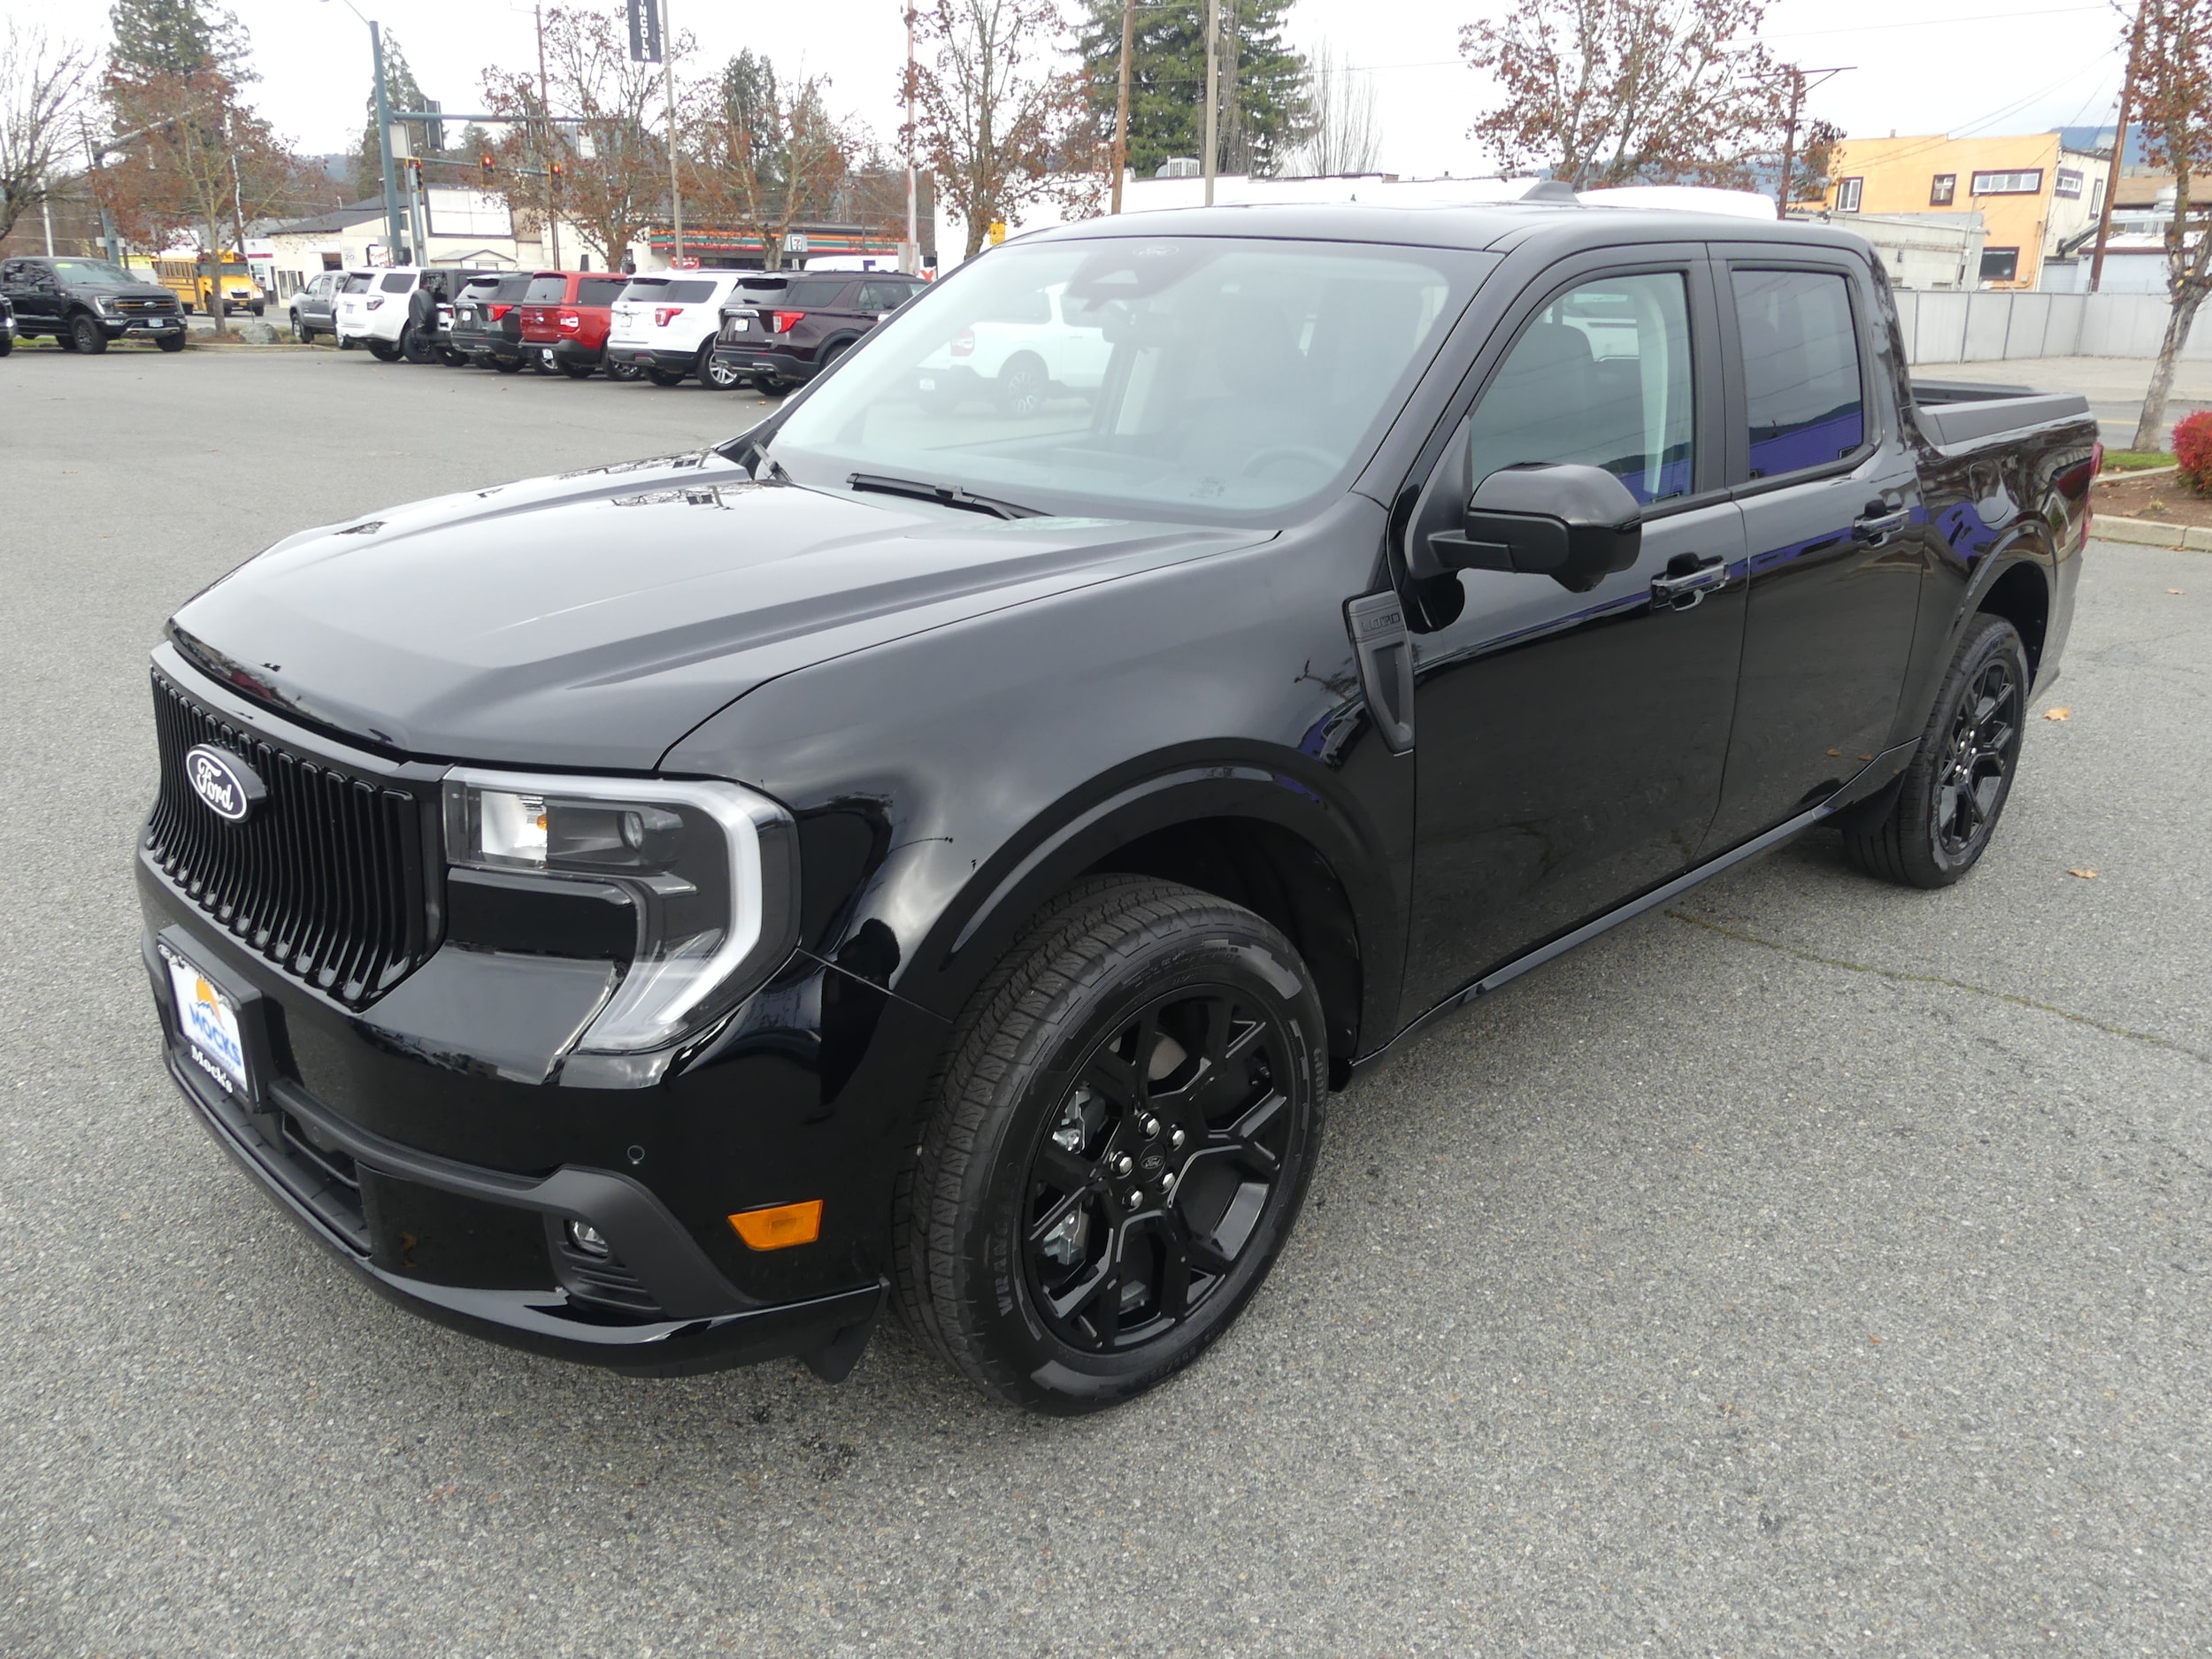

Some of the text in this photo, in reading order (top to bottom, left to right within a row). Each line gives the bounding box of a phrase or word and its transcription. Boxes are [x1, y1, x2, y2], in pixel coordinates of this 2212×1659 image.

[196, 757, 234, 810] Ford
[189, 1002, 242, 1067] MOCKS
[191, 1045, 233, 1094] Mock's
